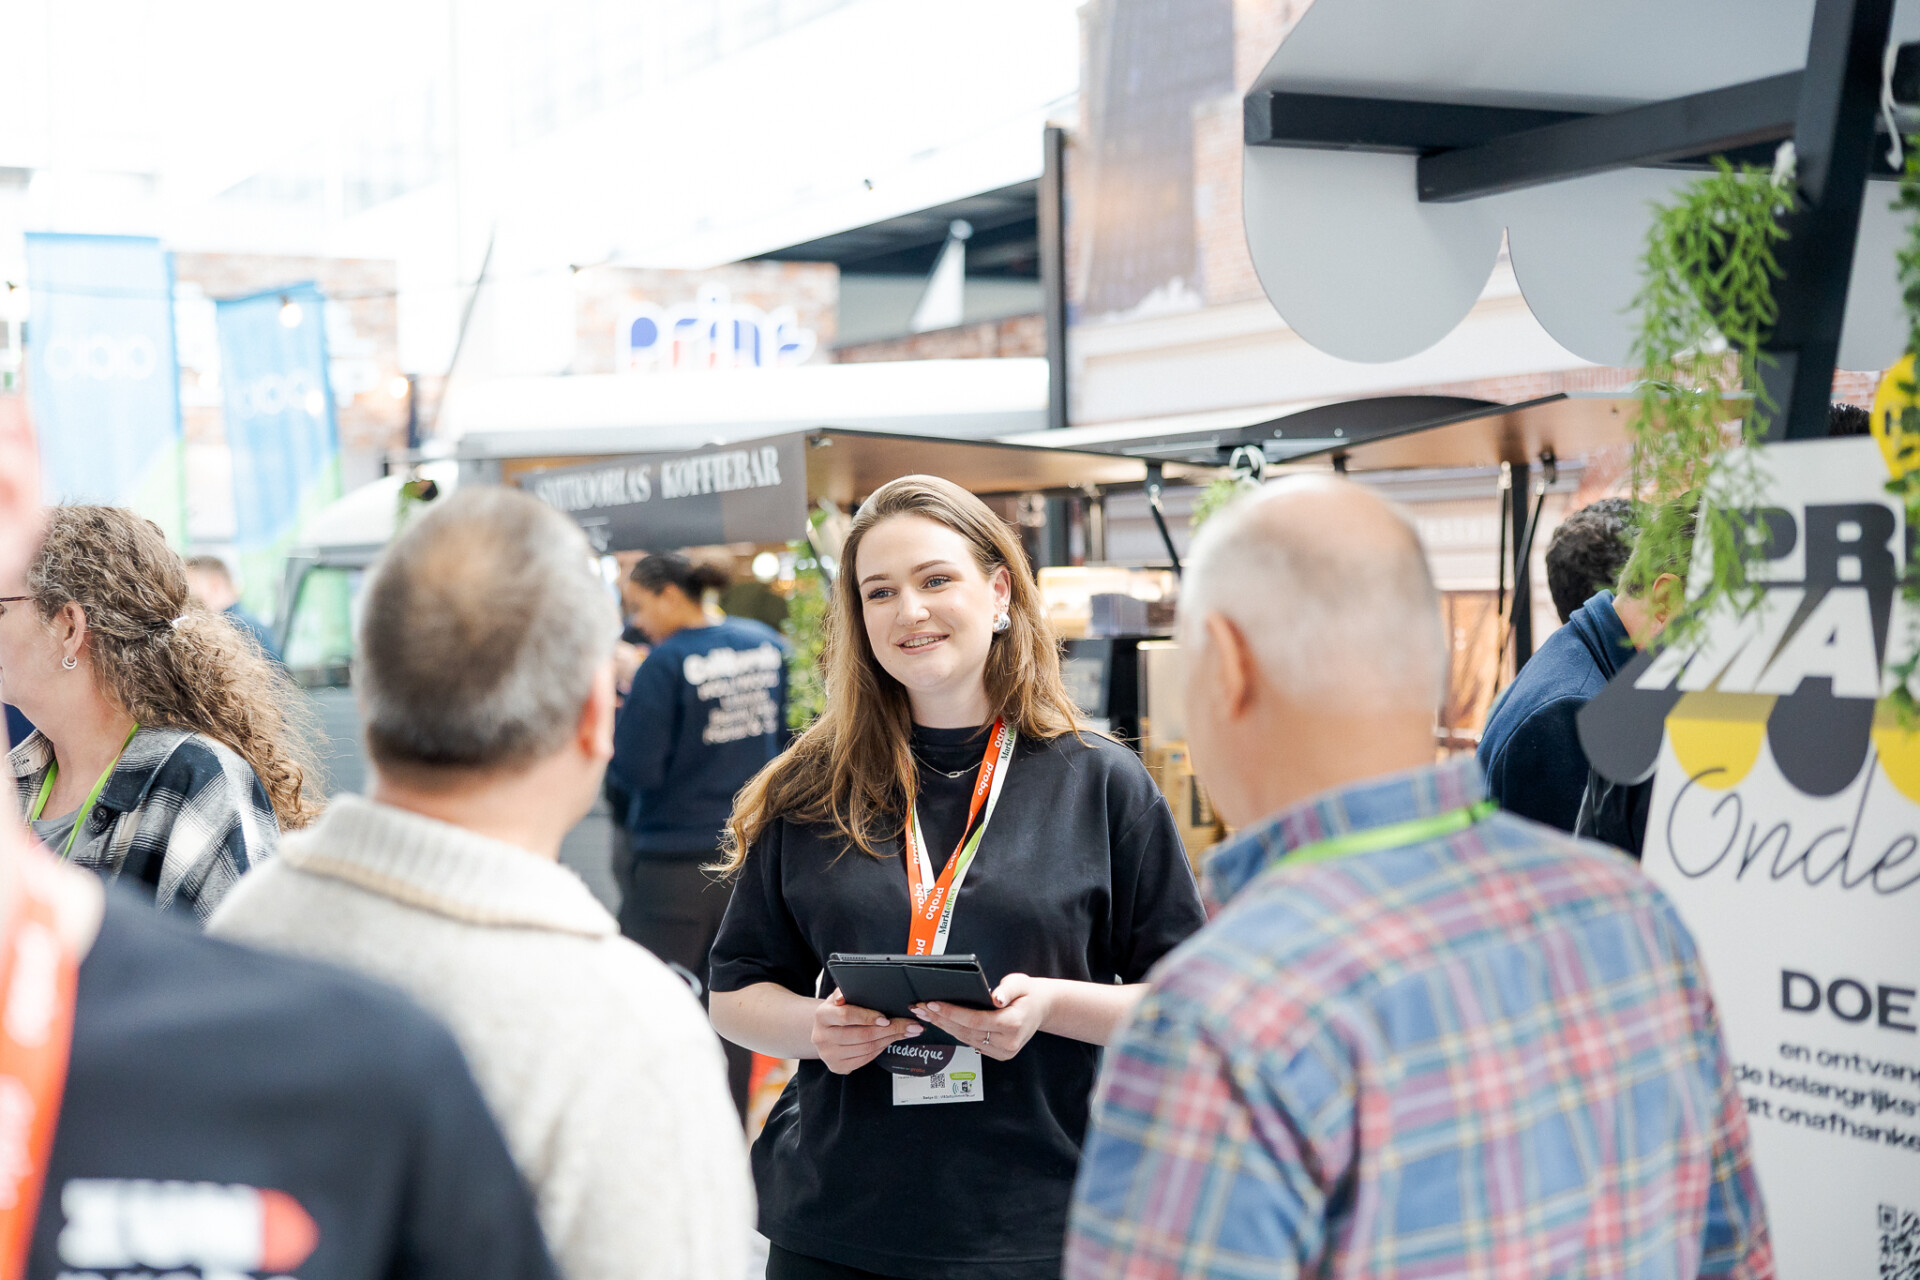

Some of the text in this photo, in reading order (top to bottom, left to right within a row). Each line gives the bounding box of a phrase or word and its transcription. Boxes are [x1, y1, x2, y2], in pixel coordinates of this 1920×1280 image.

[660, 446, 781, 499] KOFFIEBAR
[1712, 503, 1920, 586] PR
[978, 761, 994, 796] probo
[914, 882, 926, 914] robo
[926, 887, 944, 920] probo
[938, 888, 957, 935] Markteffect
[1781, 969, 1918, 1034] DOE
[1780, 1043, 1920, 1084] en ontvan
[1768, 1069, 1920, 1117] belangrijks
